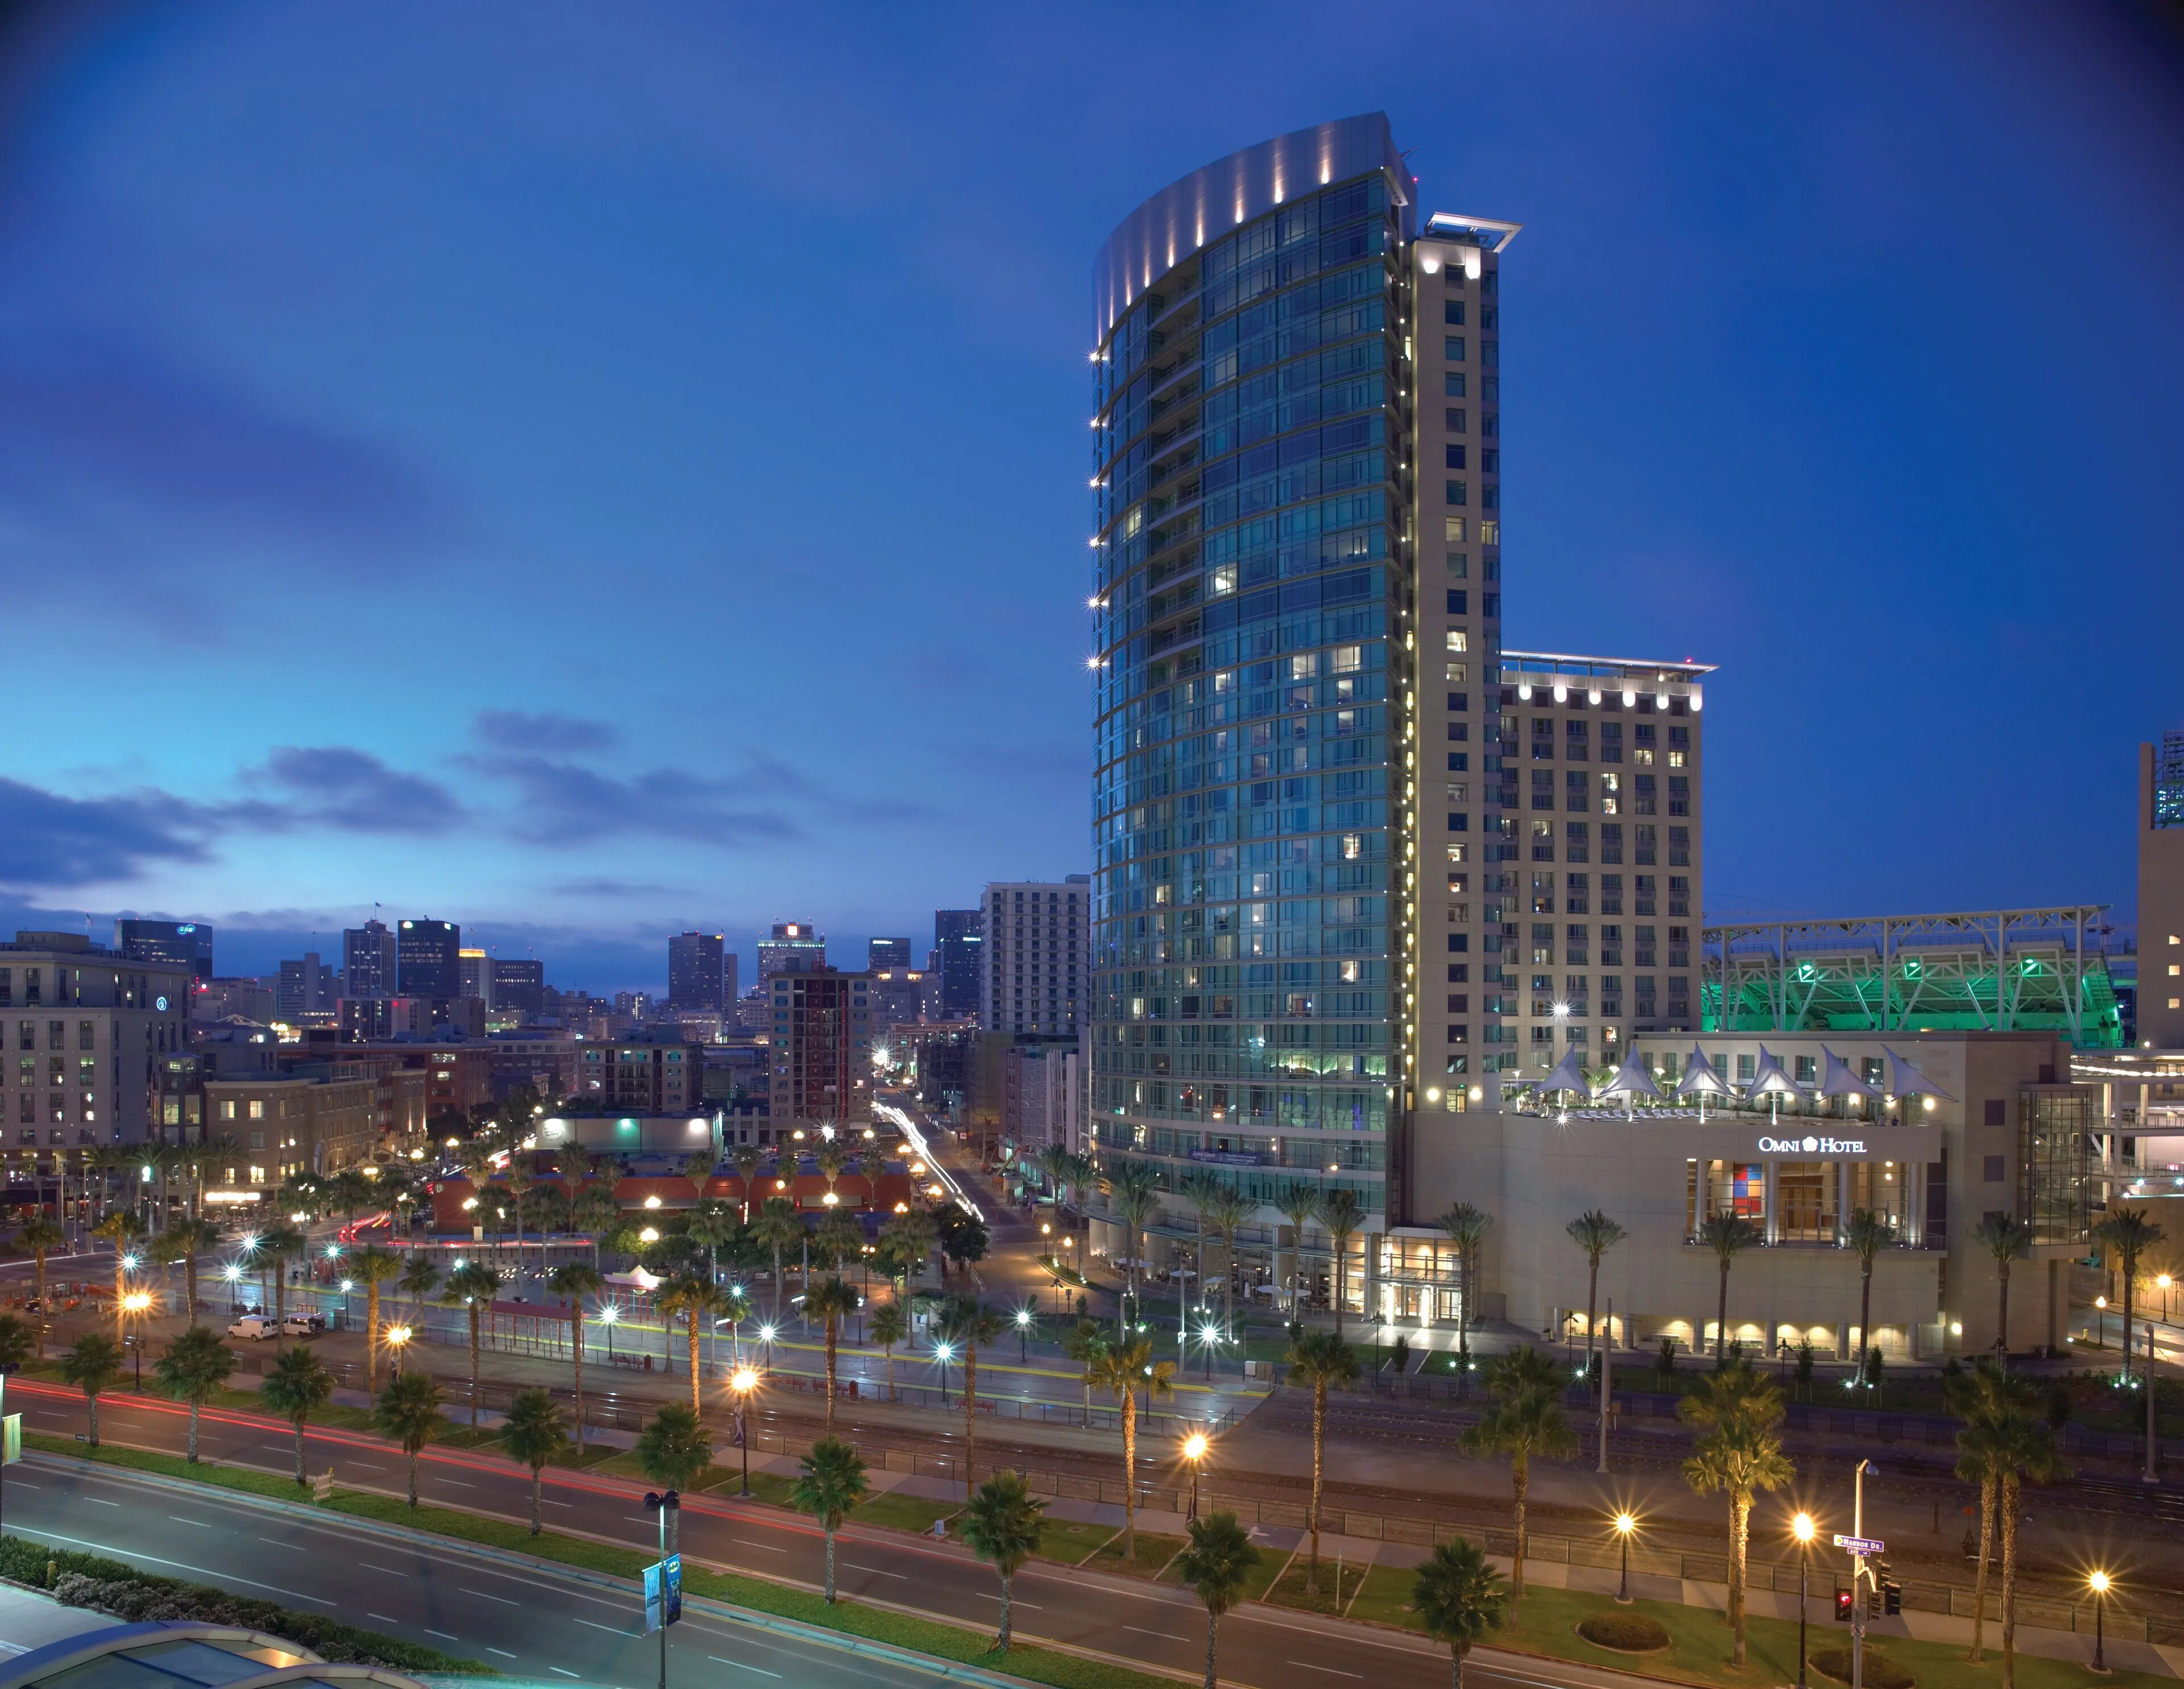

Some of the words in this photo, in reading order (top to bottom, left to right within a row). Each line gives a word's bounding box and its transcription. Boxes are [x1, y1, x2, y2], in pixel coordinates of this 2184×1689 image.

[1759, 1137, 1800, 1152] OMNI
[1819, 1138, 1867, 1153] HOTEL
[1843, 1538, 1868, 1548] HARBOR
